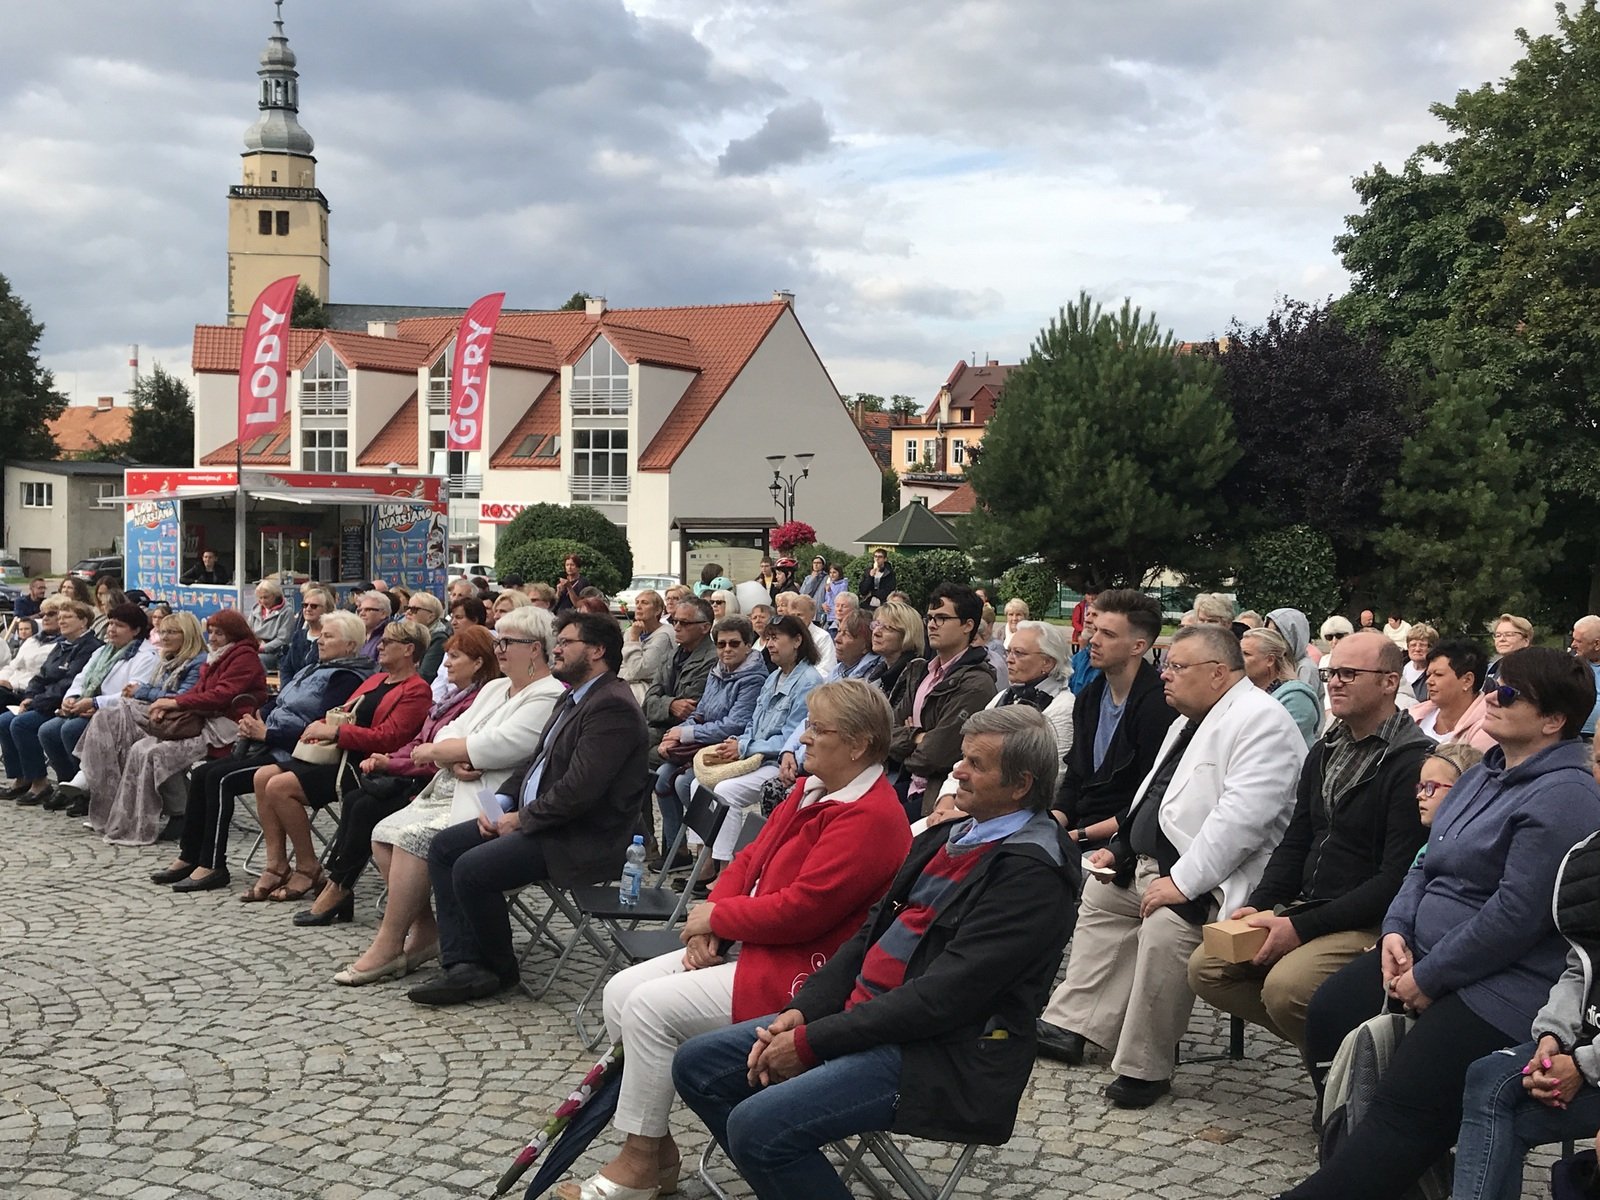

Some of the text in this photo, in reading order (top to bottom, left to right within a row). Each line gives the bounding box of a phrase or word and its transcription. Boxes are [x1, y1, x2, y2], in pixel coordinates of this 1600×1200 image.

[246, 303, 286, 425] LODY
[448, 318, 492, 444] GOFRY
[378, 508, 432, 531] MARSJANO
